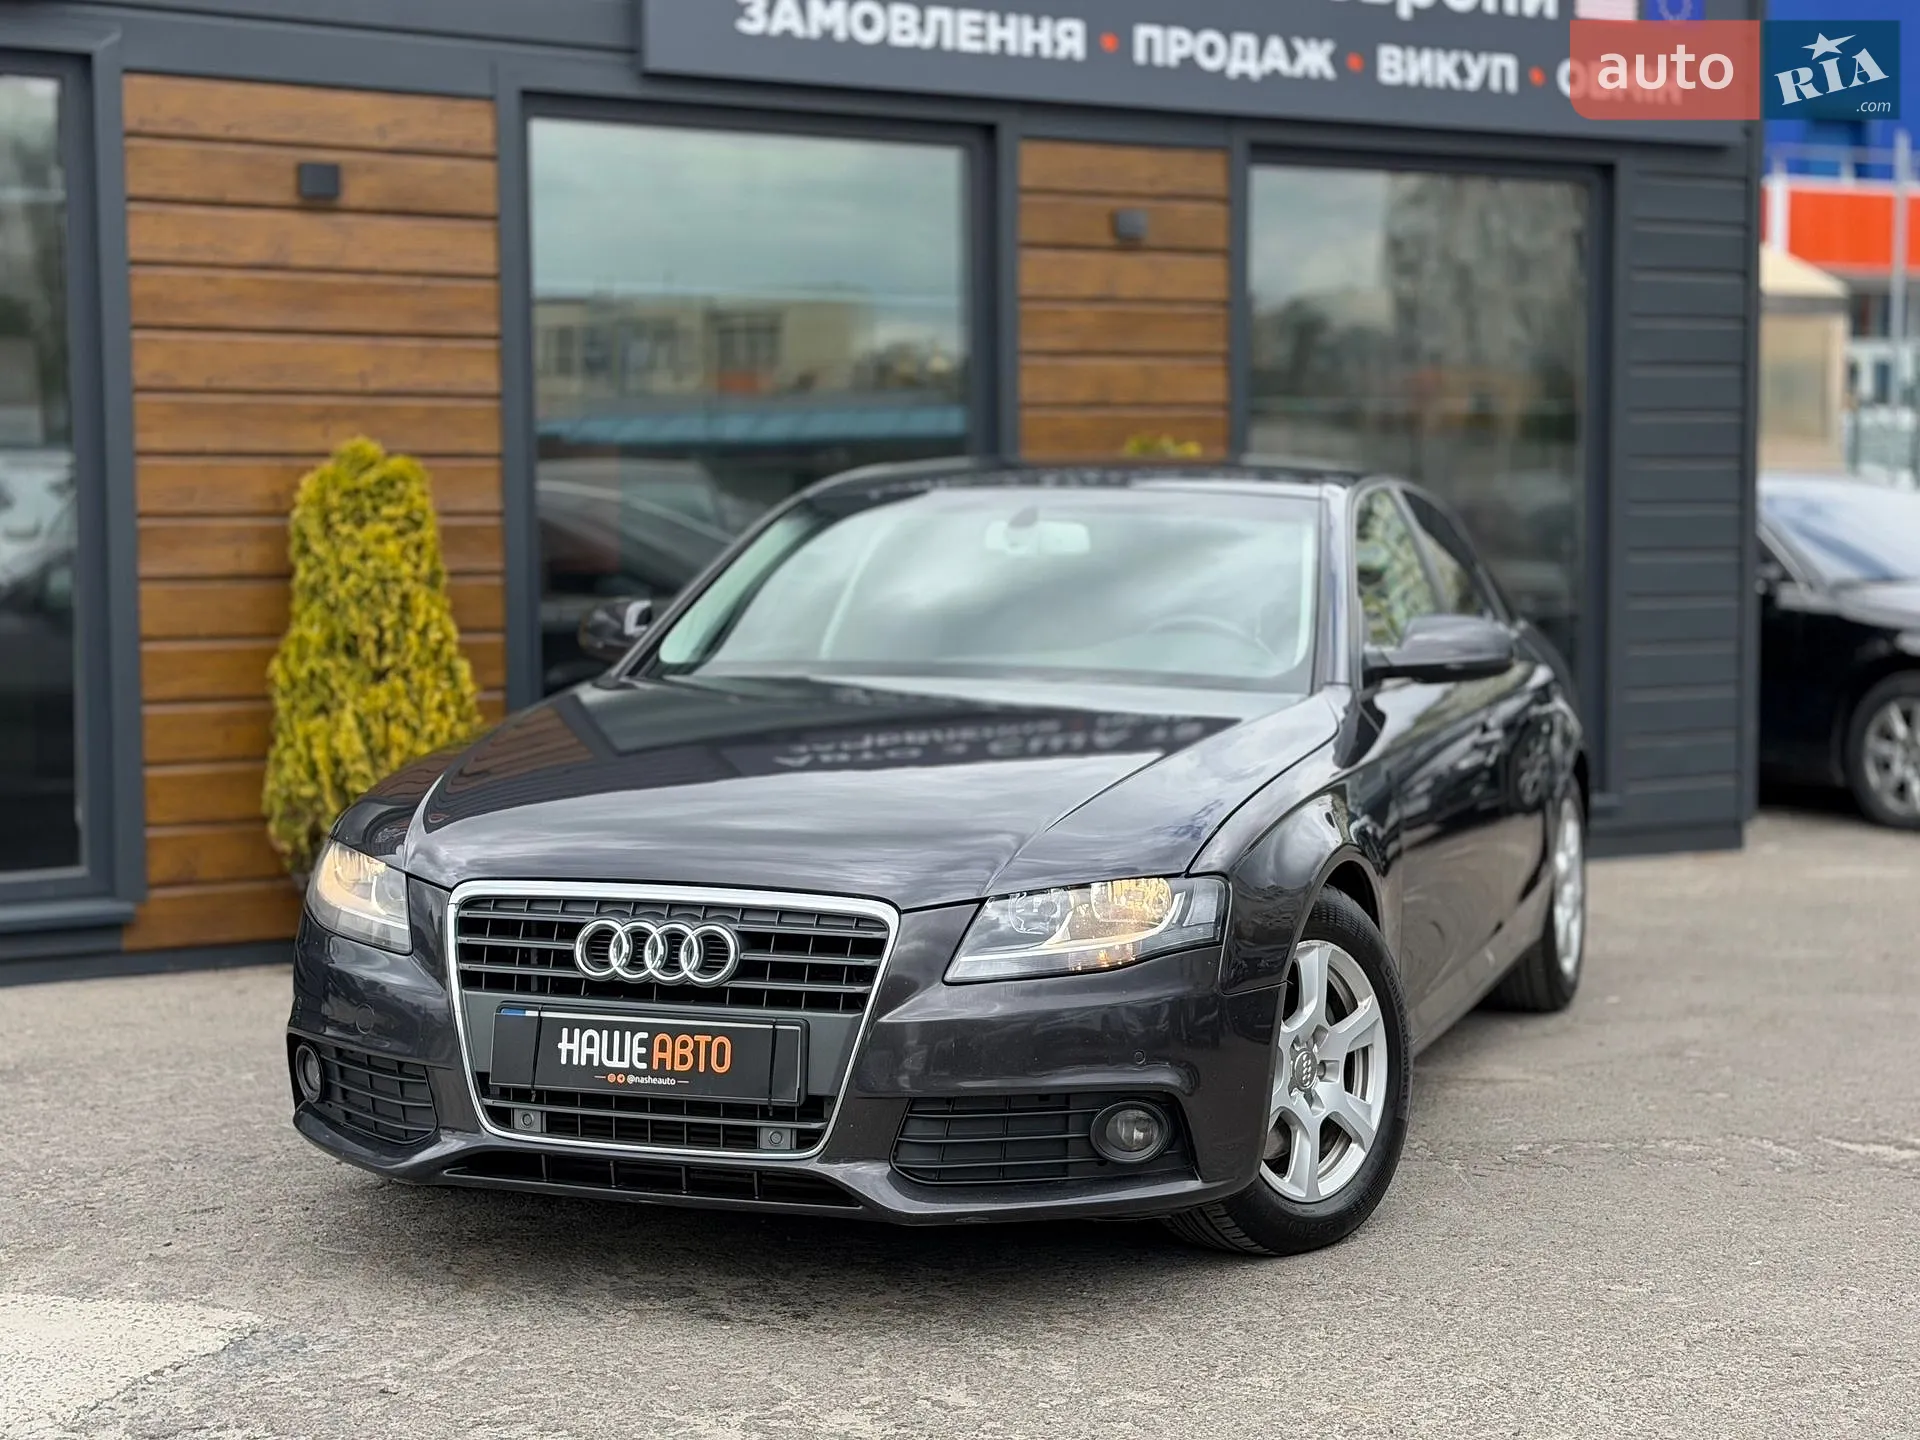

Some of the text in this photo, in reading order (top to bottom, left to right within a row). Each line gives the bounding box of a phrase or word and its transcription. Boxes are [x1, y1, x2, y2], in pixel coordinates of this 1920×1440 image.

[735, 0, 1086, 61] ЗАМОВЛЕННЯ
[1132, 23, 1337, 82] ПРОДАЖ
[1376, 43, 1519, 95] ВИКУП
[557, 1027, 732, 1074] НАШЕ АВТО
[626, 1074, 677, 1087] @nasheauto
